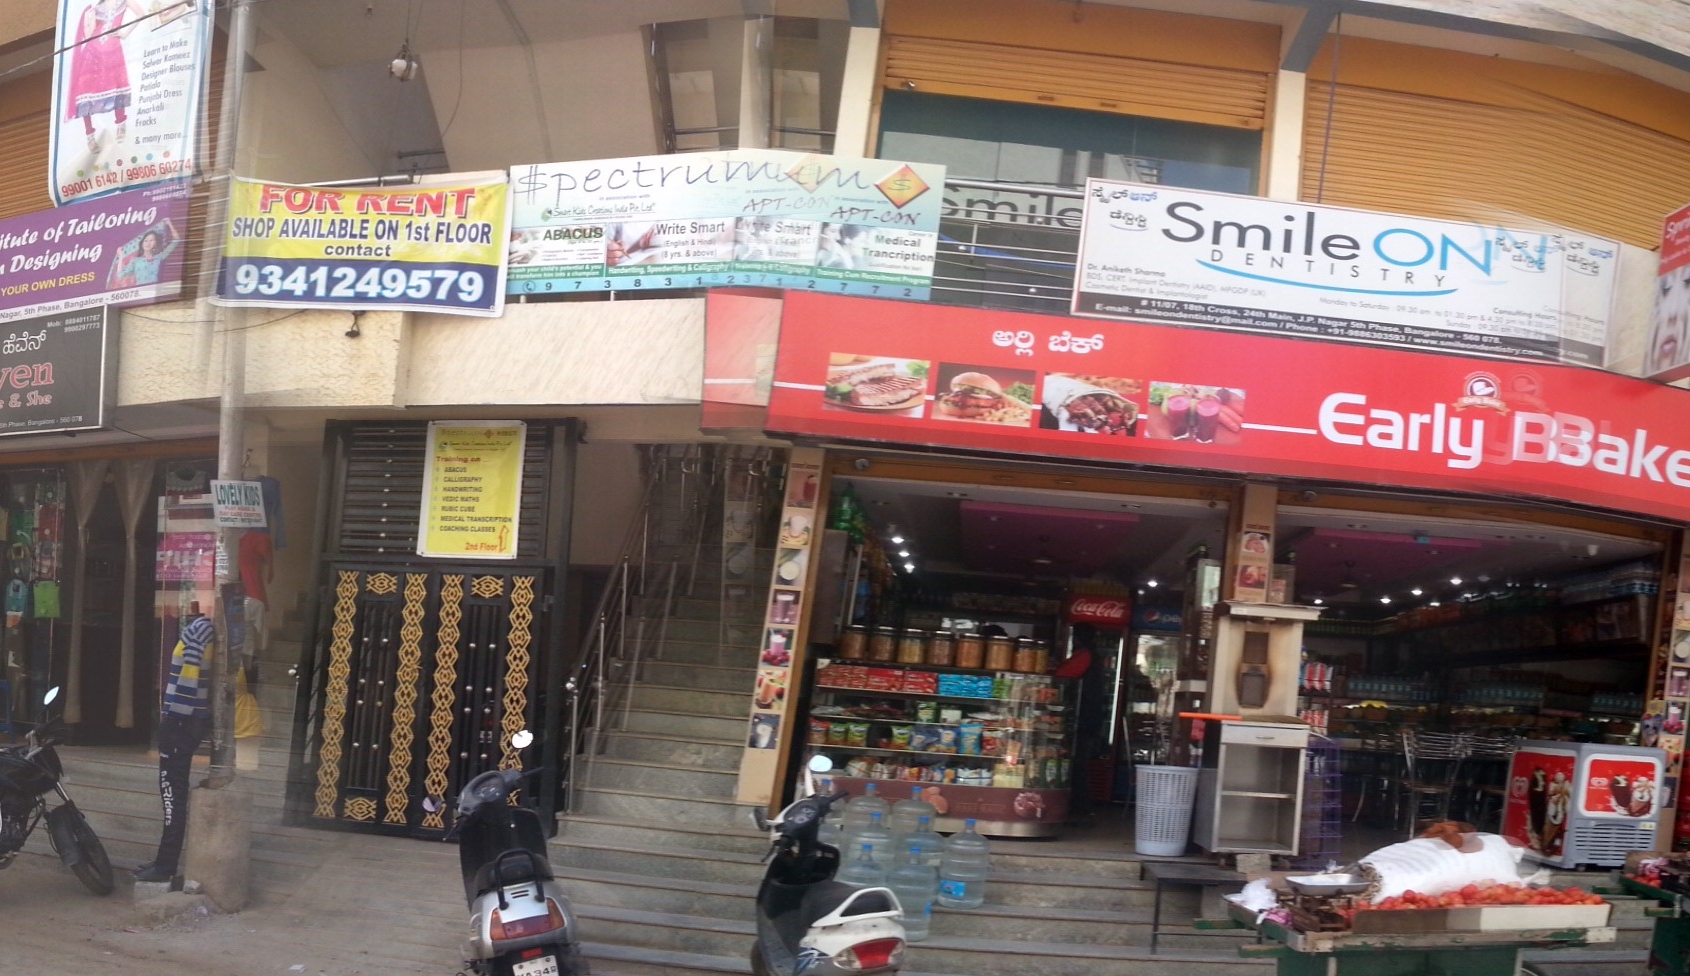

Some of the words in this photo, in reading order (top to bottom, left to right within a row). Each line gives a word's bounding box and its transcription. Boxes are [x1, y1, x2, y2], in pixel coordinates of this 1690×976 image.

[143, 46, 161, 58] Learn
[162, 45, 169, 53] to
[169, 39, 188, 51] Make
[142, 58, 162, 70] Salwar
[164, 51, 190, 64] Kameez
[141, 67, 168, 82] Designer
[169, 62, 196, 73] Blouses
[139, 93, 163, 105] Punjabi
[163, 89, 183, 99] Dress
[142, 134, 161, 145] many
[61, 177, 94, 198] 99001
[125, 163, 157, 181] 99806
[260, 185, 344, 214] FOR
[356, 188, 476, 218] RENT
[43, 222, 64, 247] of
[66, 205, 157, 237] Tailoring
[233, 217, 275, 238] SHOP
[279, 218, 368, 240] AVAILABLE
[375, 220, 399, 241] ON
[405, 221, 429, 241] 1st
[436, 222, 492, 244] FLOOR
[543, 227, 603, 241] ABACUS
[656, 222, 687, 236] Write
[690, 221, 725, 234] Smart
[324, 243, 391, 257] contact
[875, 235, 921, 247] Medical
[9, 243, 104, 273] Designing
[863, 248, 934, 262] Trancription
[1211, 249, 1445, 287] DENTISTRY
[1, 282, 30, 297] YOUR
[31, 278, 56, 292] OWN
[58, 271, 96, 288] DRESS
[235, 264, 484, 303] 9341249579
[0, 309, 22, 322] Nagar,
[24, 305, 35, 315] 5th
[37, 302, 62, 315] Phase,
[63, 296, 103, 311] Bangalore
[1095, 303, 1132, 313] E-mail:
[1285, 322, 1318, 333] Phone
[1183, 303, 1205, 312] 18th
[1208, 306, 1241, 316] Cross,
[1243, 309, 1266, 319] 24th
[1268, 312, 1295, 322] Main,
[1318, 318, 1348, 328] Nagar
[1368, 323, 1402, 333] Phase,
[1404, 327, 1454, 339] Bangalore
[8, 393, 21, 408] &
[26, 390, 52, 406] She
[1318, 392, 1484, 469] Early
[214, 484, 242, 506] LOVELY
[243, 484, 261, 506] KIDS
[465, 542, 478, 551] 2nd
[479, 542, 499, 552] Floor
